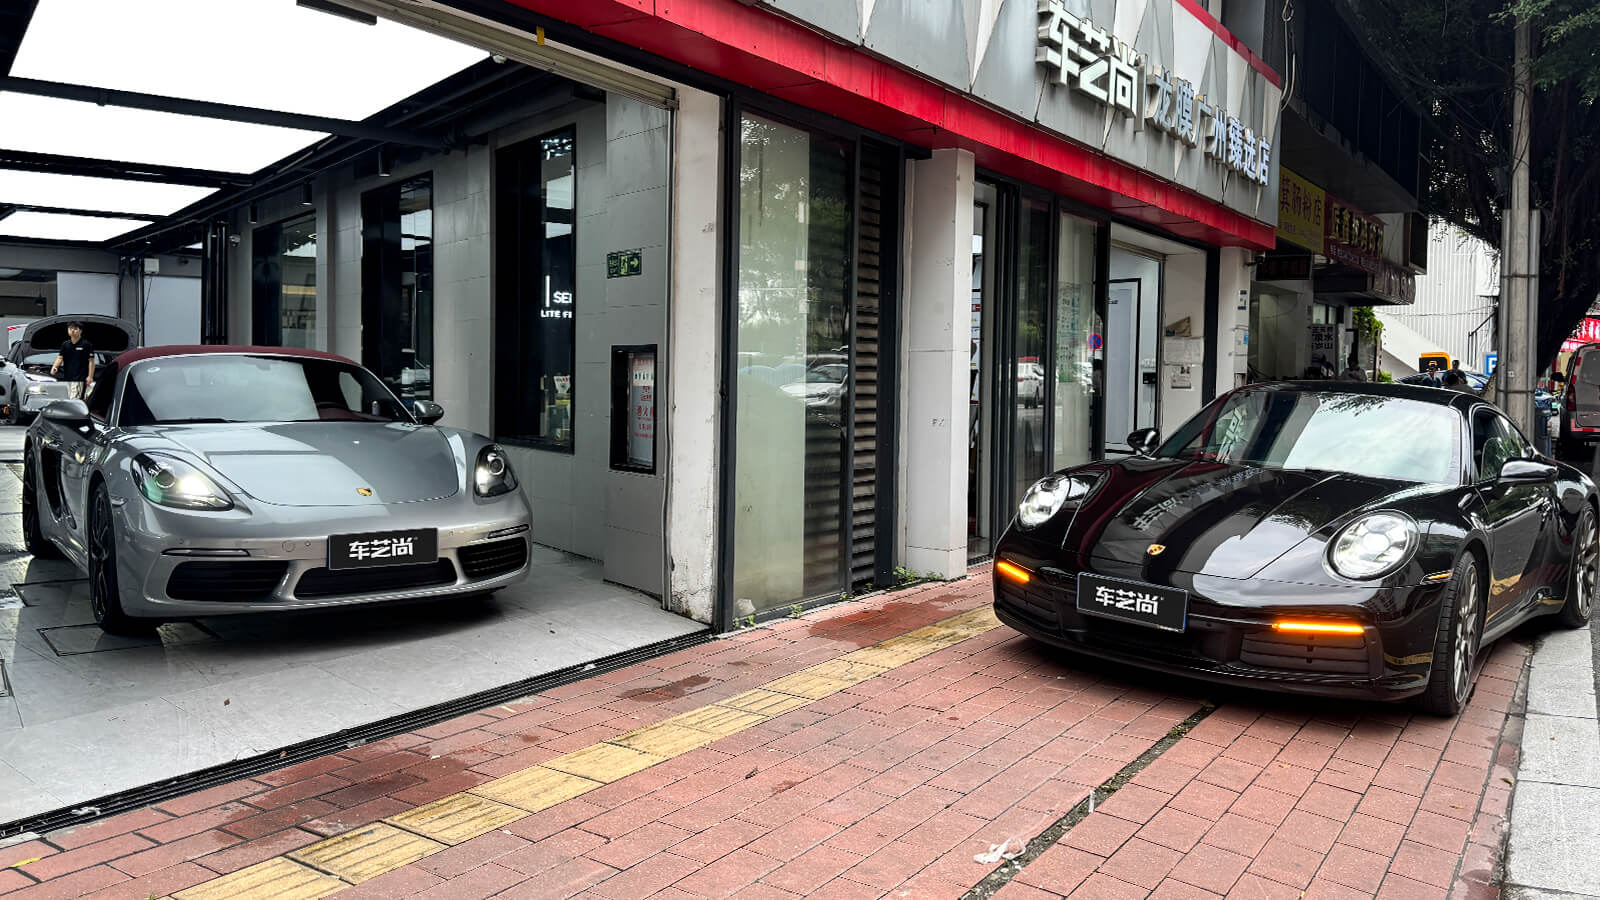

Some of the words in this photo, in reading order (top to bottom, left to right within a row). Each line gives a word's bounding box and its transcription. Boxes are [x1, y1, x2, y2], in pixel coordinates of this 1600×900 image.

[1045, 0, 1138, 117] 车艺尚
[1152, 65, 1270, 186] 龙膜广州臻选店
[348, 537, 414, 560] 车艺尚
[1095, 586, 1159, 615] 车艺尚
